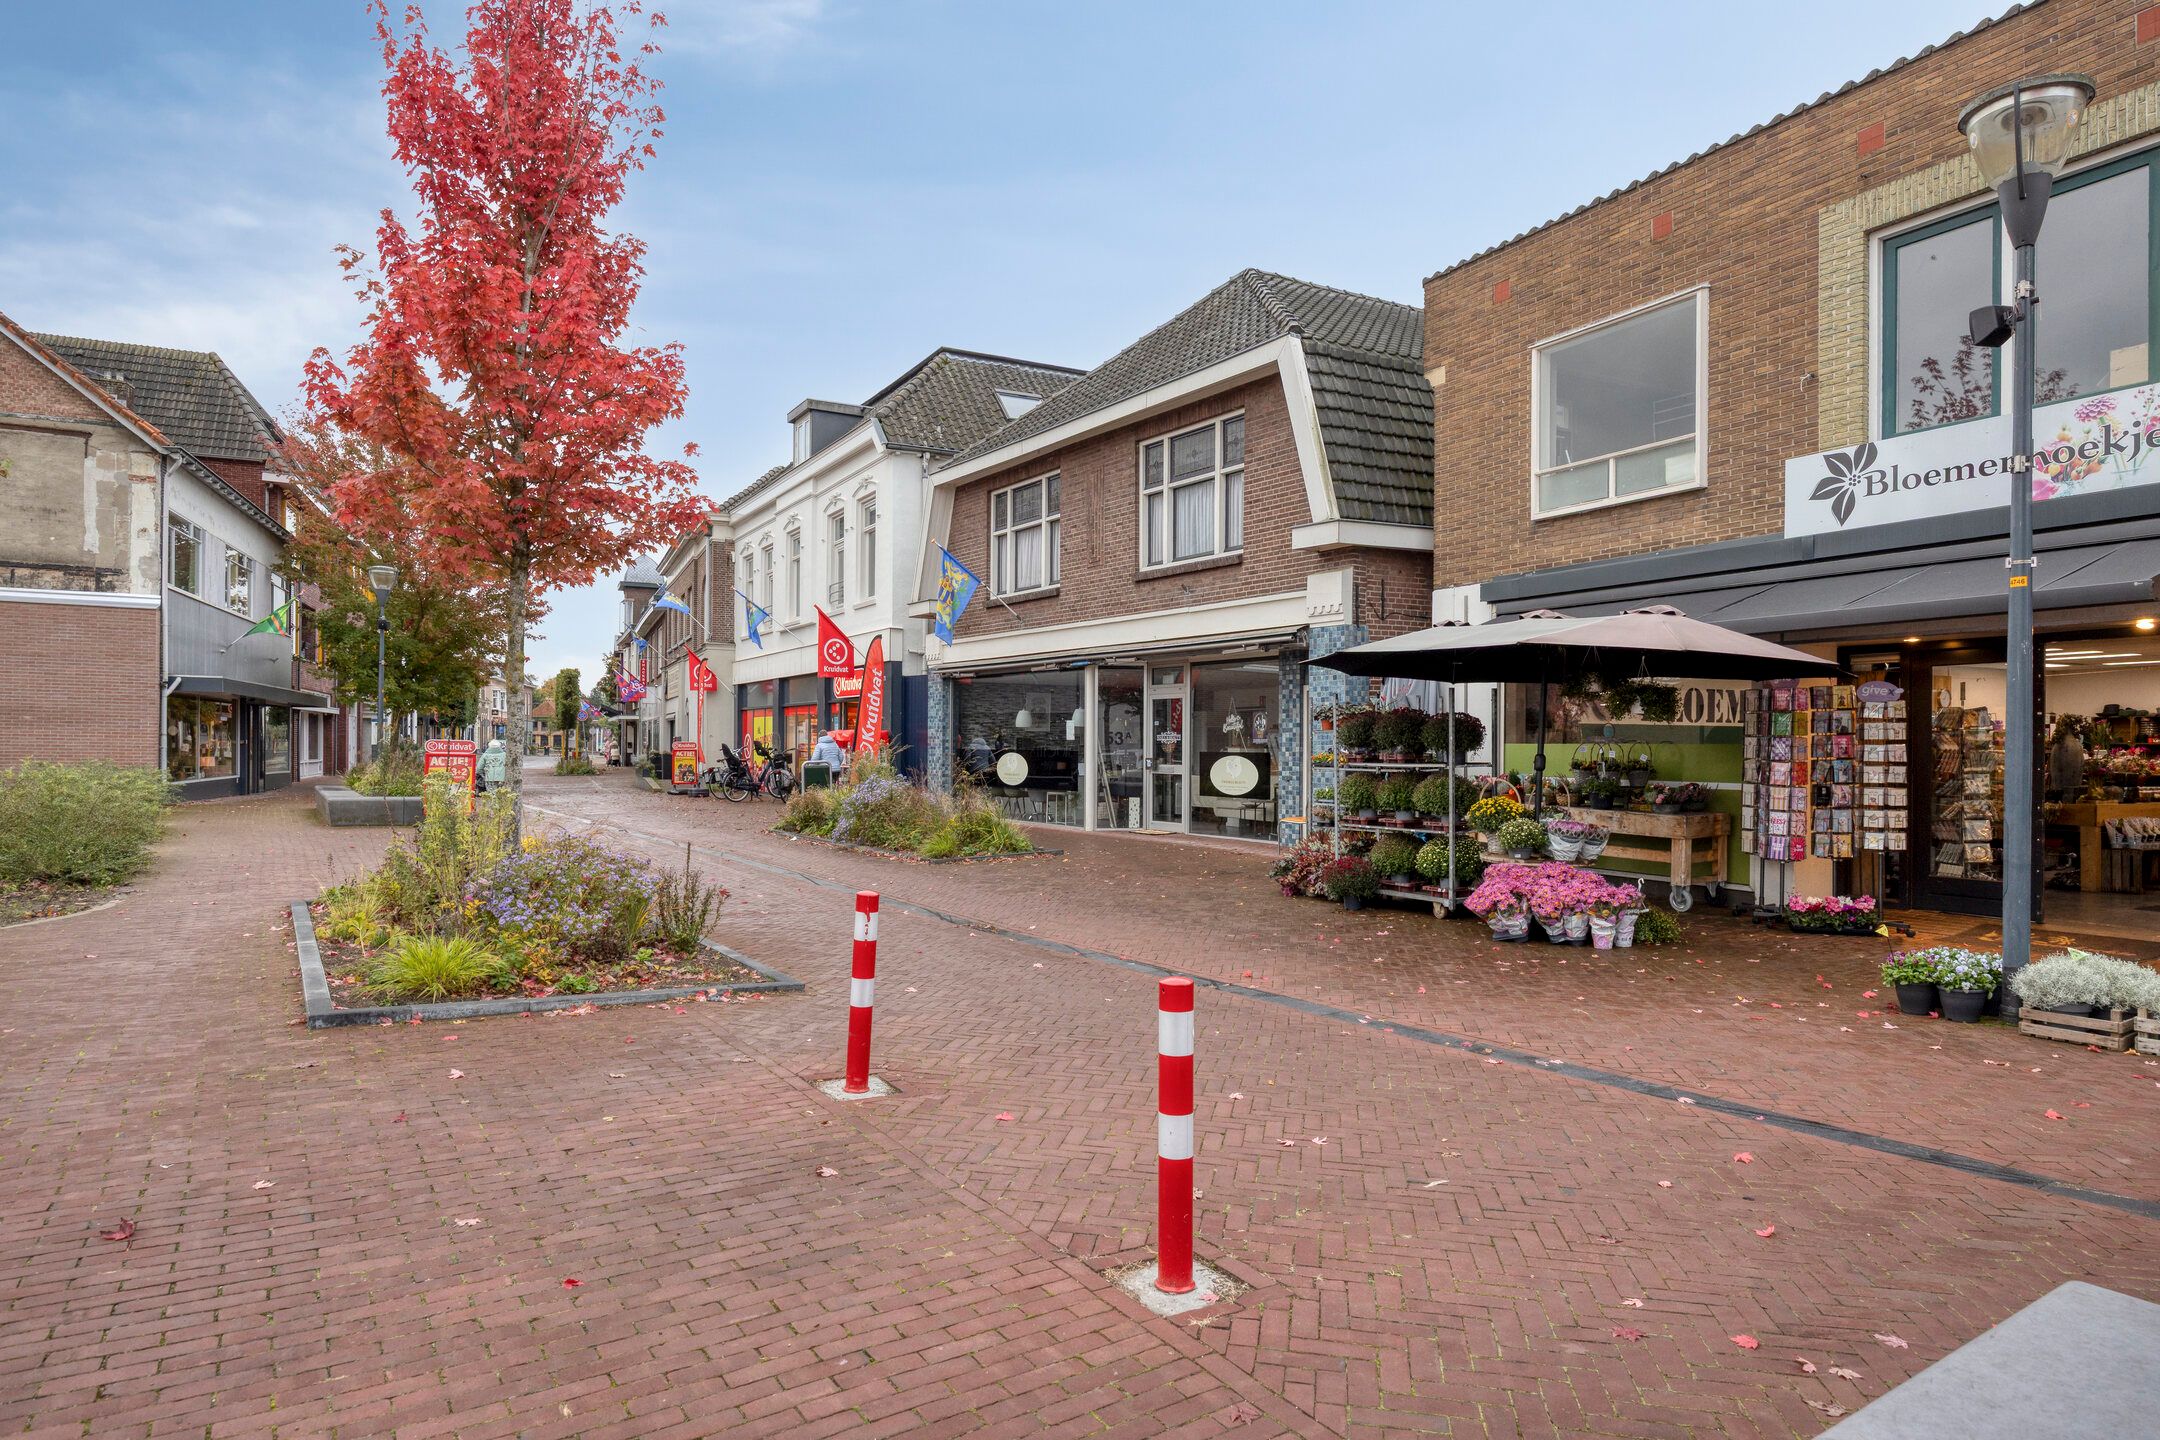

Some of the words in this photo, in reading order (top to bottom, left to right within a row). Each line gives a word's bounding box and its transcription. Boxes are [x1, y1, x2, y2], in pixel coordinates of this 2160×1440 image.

[841, 675, 863, 691] Kruidva
[862, 668, 882, 742] Kruidvat
[451, 767, 468, 776] 3+2
